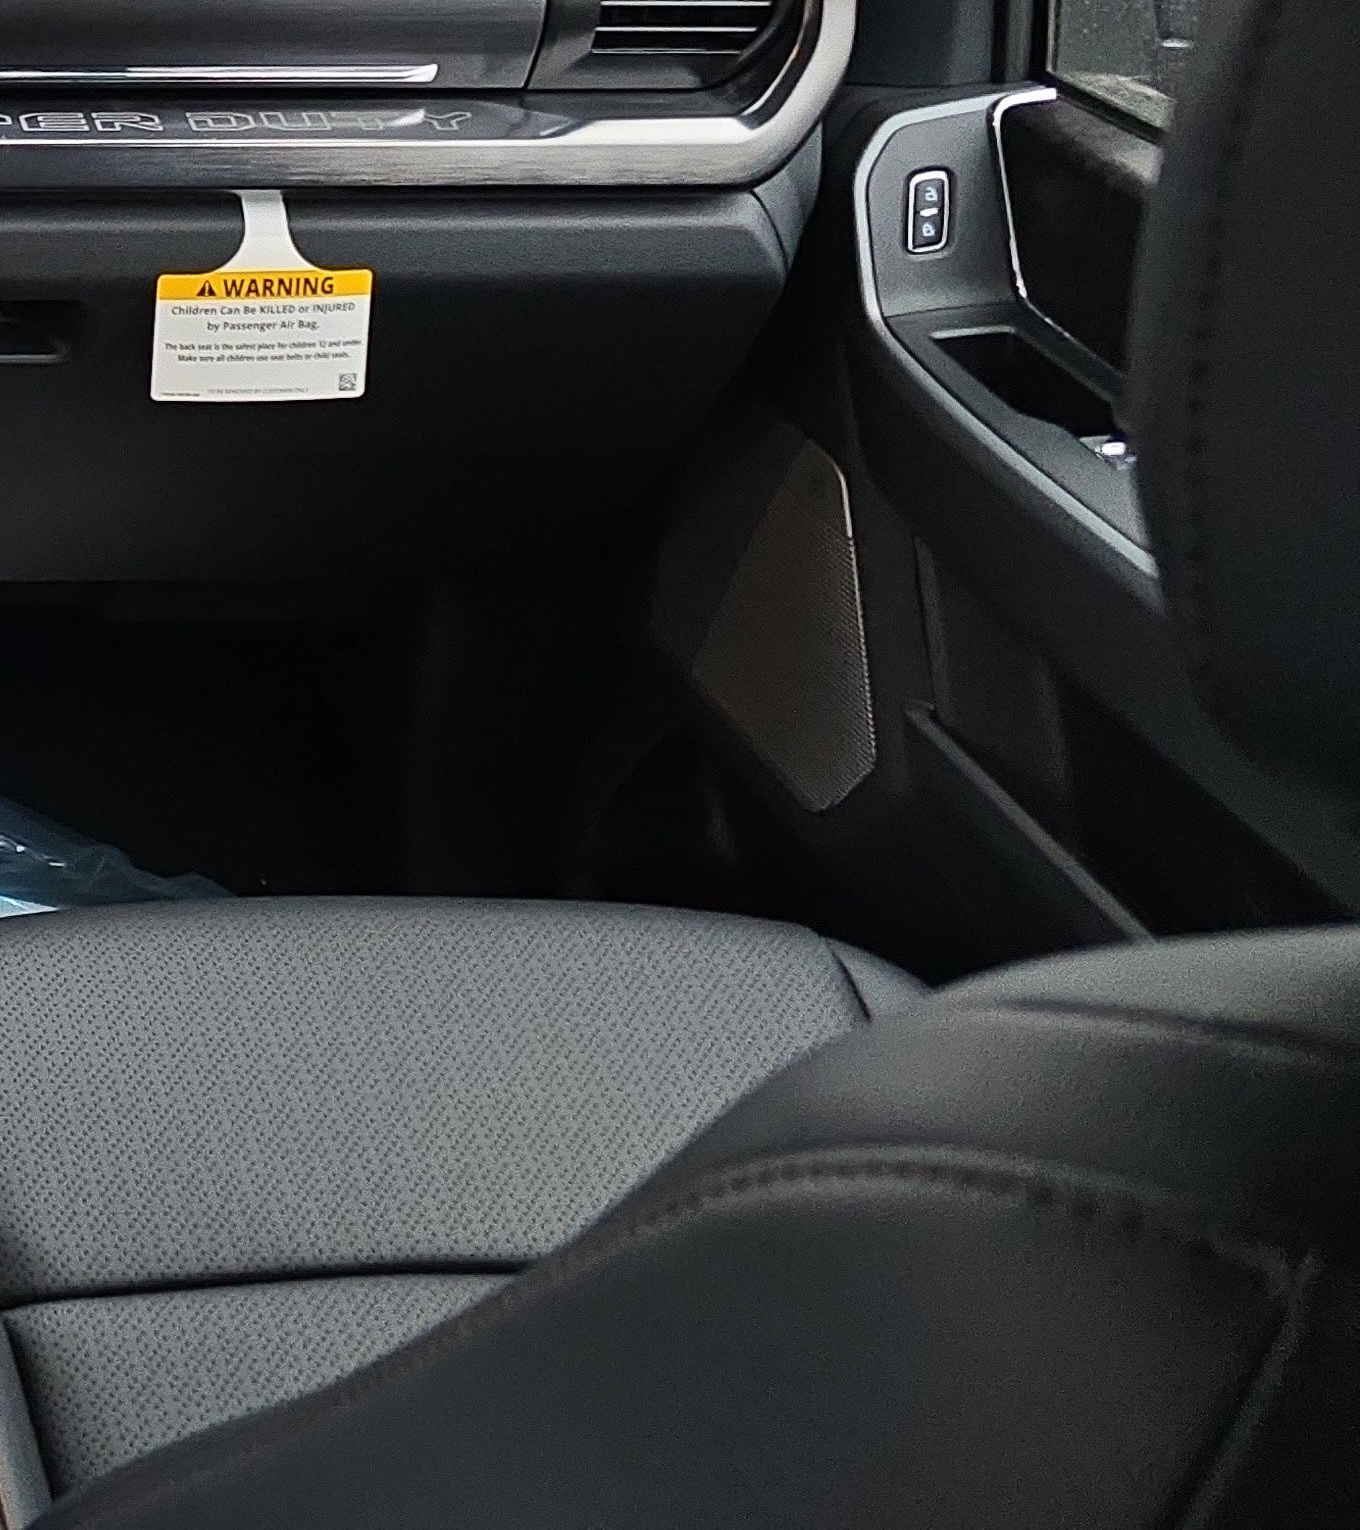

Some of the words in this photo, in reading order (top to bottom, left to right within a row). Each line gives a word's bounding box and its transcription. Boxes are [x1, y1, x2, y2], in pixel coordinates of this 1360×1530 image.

[186, 109, 473, 132] DUTY
[223, 276, 334, 297] WARNING
[171, 306, 217, 316] Children
[220, 306, 241, 315] Can
[243, 305, 256, 314] Be
[259, 305, 295, 314] KILLED
[312, 302, 355, 314] INJURED
[207, 322, 220, 332] by
[223, 321, 276, 332] Passenger
[280, 321, 294, 329] Air
[298, 320, 319, 331] Bag.
[180, 343, 195, 351] back
[198, 343, 212, 351] seat
[258, 343, 275, 351] place
[289, 341, 316, 349] children
[318, 341, 326, 349] 12
[178, 354, 197, 362] Make
[216, 354, 225, 362] all
[227, 354, 254, 362] children
[314, 352, 329, 360] child
